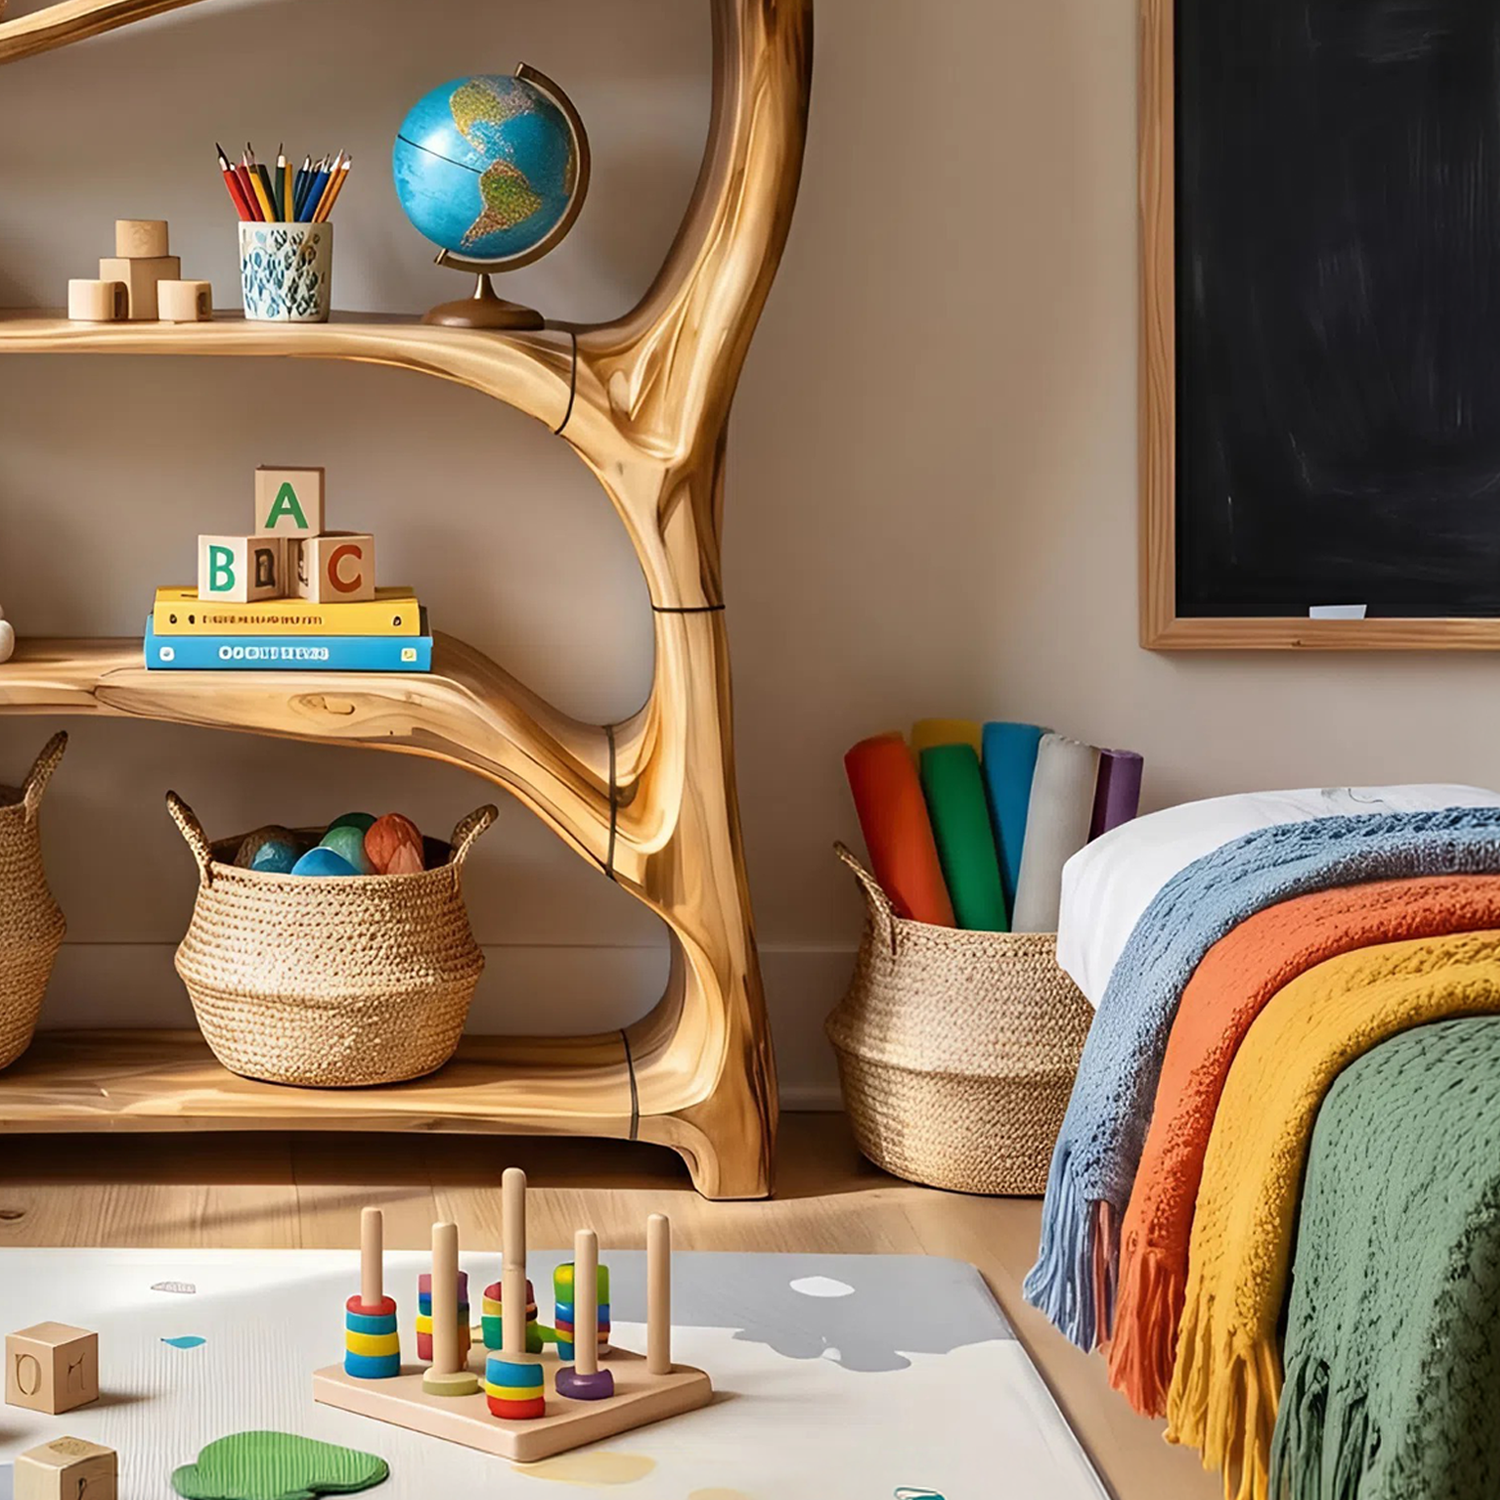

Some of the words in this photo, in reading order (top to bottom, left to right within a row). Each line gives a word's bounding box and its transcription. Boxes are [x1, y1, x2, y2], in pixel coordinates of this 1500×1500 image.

[264, 482, 309, 529] A
[209, 545, 235, 592] B
[327, 544, 363, 593] C
